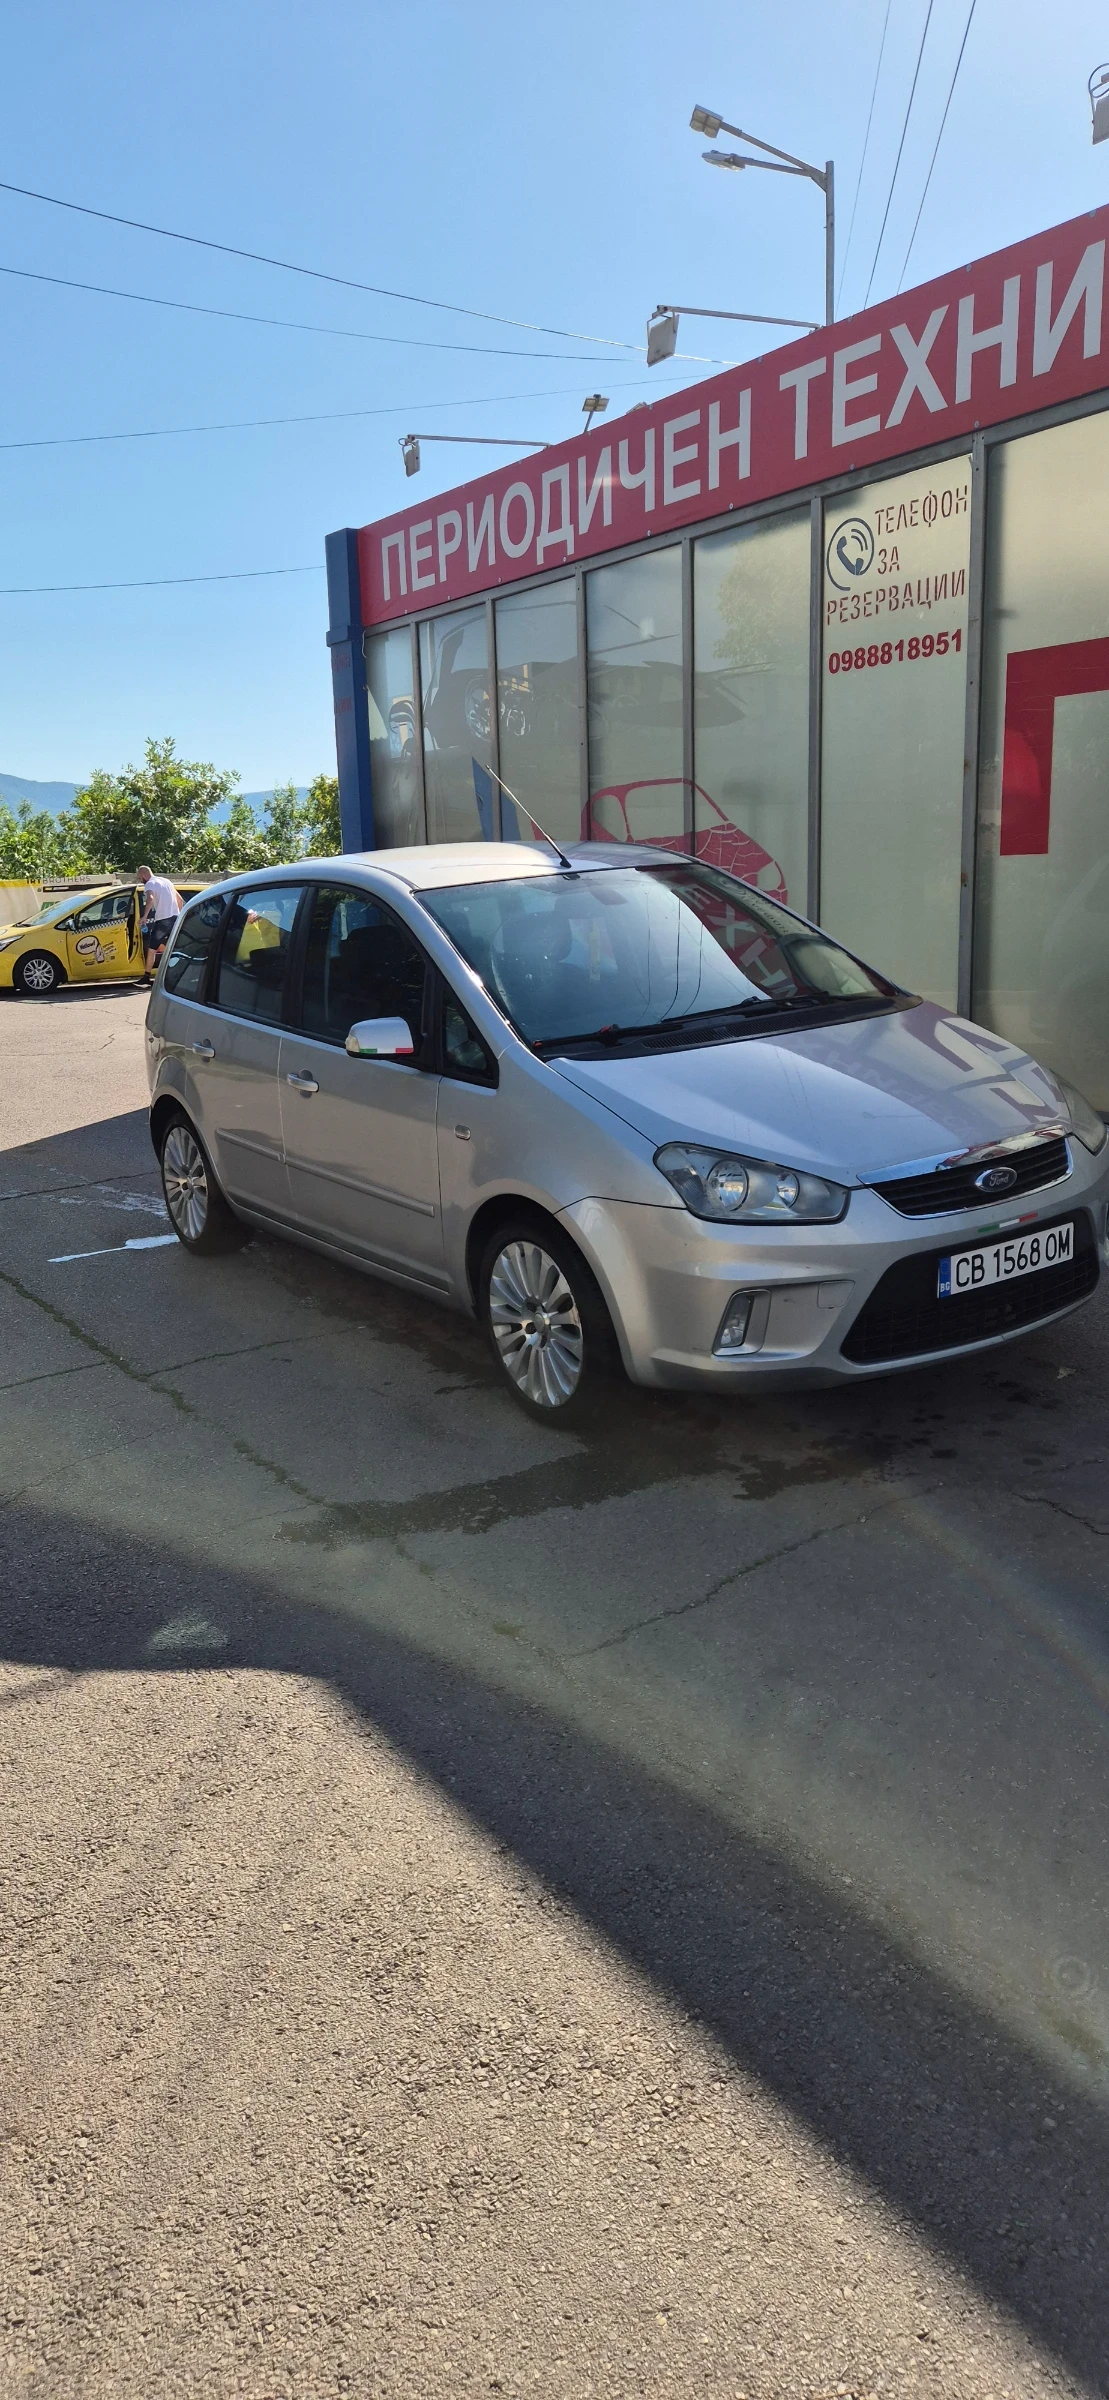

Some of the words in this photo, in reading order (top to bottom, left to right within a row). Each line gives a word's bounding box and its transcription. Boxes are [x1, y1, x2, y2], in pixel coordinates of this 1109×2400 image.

[381, 387, 752, 602] ПЕРИОДИЧЕН
[779, 239, 1106, 461] ТЕХНИ
[874, 485, 968, 536] ТЕЛЕФОН
[877, 546, 900, 575] ЗА
[827, 569, 965, 626] РЕЗЕРВАЦИИ
[828, 628, 962, 674] 0988818951
[989, 1171, 1010, 1187] Ford
[956, 1254, 985, 1288] CB
[993, 1238, 1041, 1278] 1568
[1045, 1228, 1071, 1262] OM
[940, 1282, 951, 1292] BG
